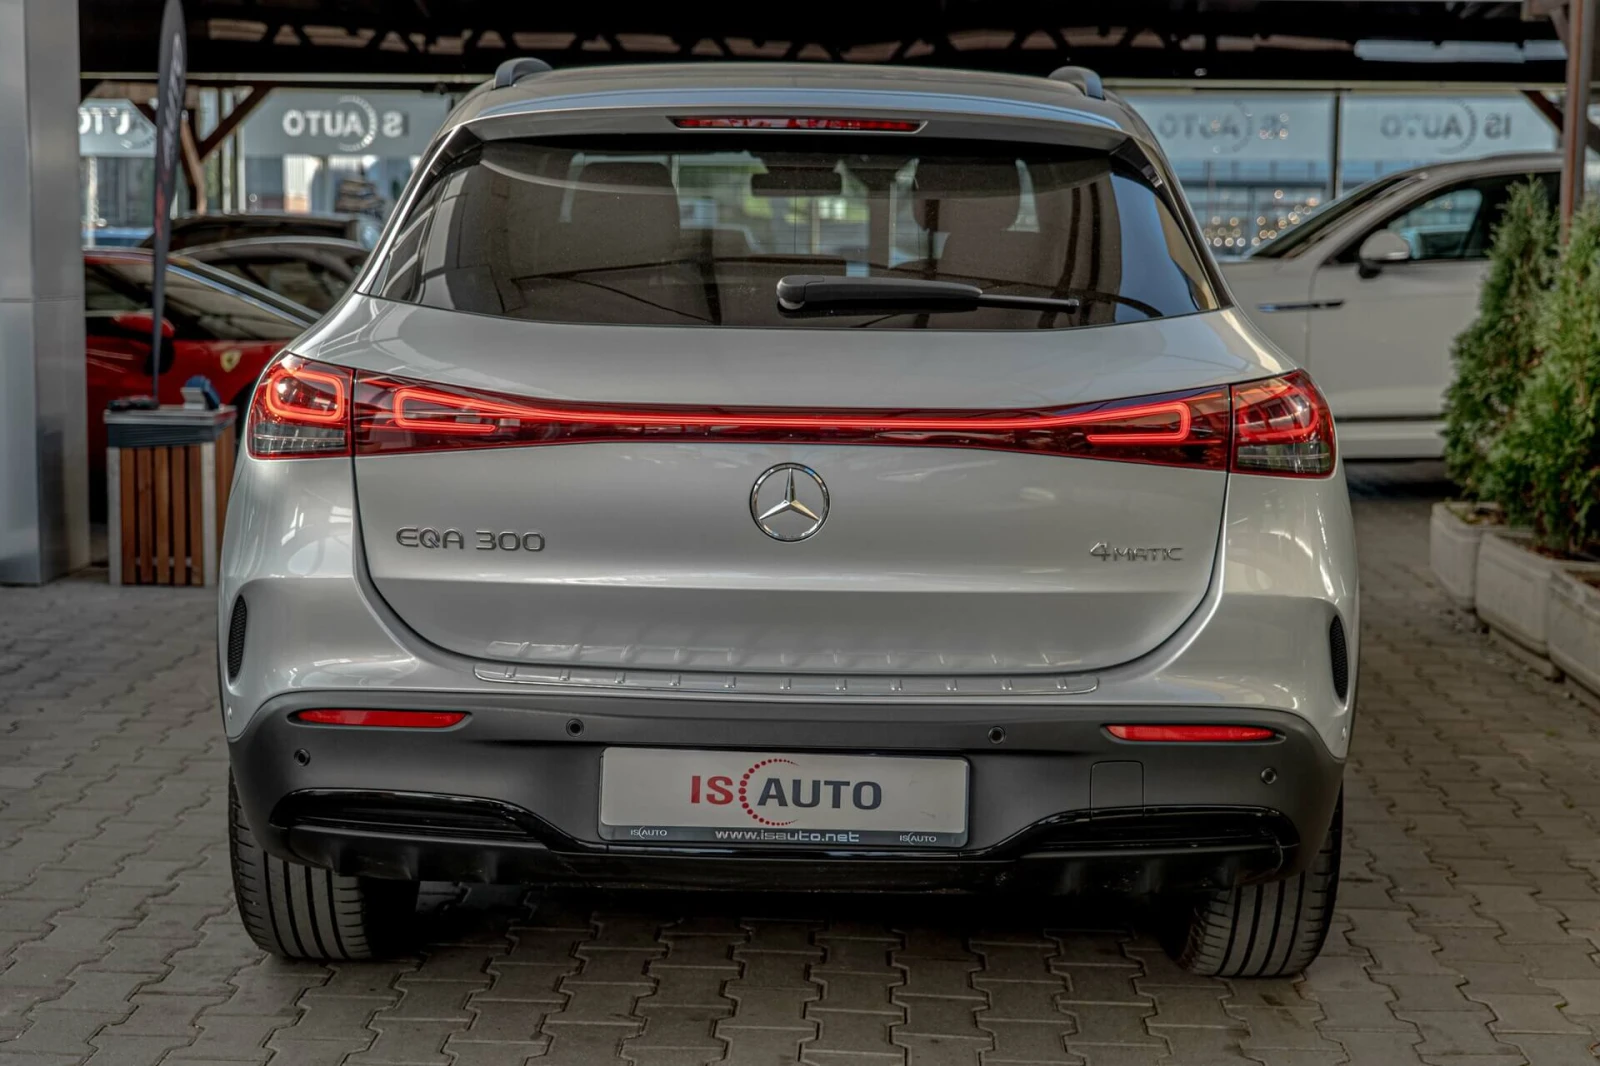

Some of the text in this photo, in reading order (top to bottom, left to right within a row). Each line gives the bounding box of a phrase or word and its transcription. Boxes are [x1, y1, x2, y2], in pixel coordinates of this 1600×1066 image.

[396, 526, 545, 552] EQA 300
[1089, 542, 1184, 562] 4MATIC
[690, 775, 883, 810] IS AUTO
[715, 829, 860, 843] www.isauto.net
